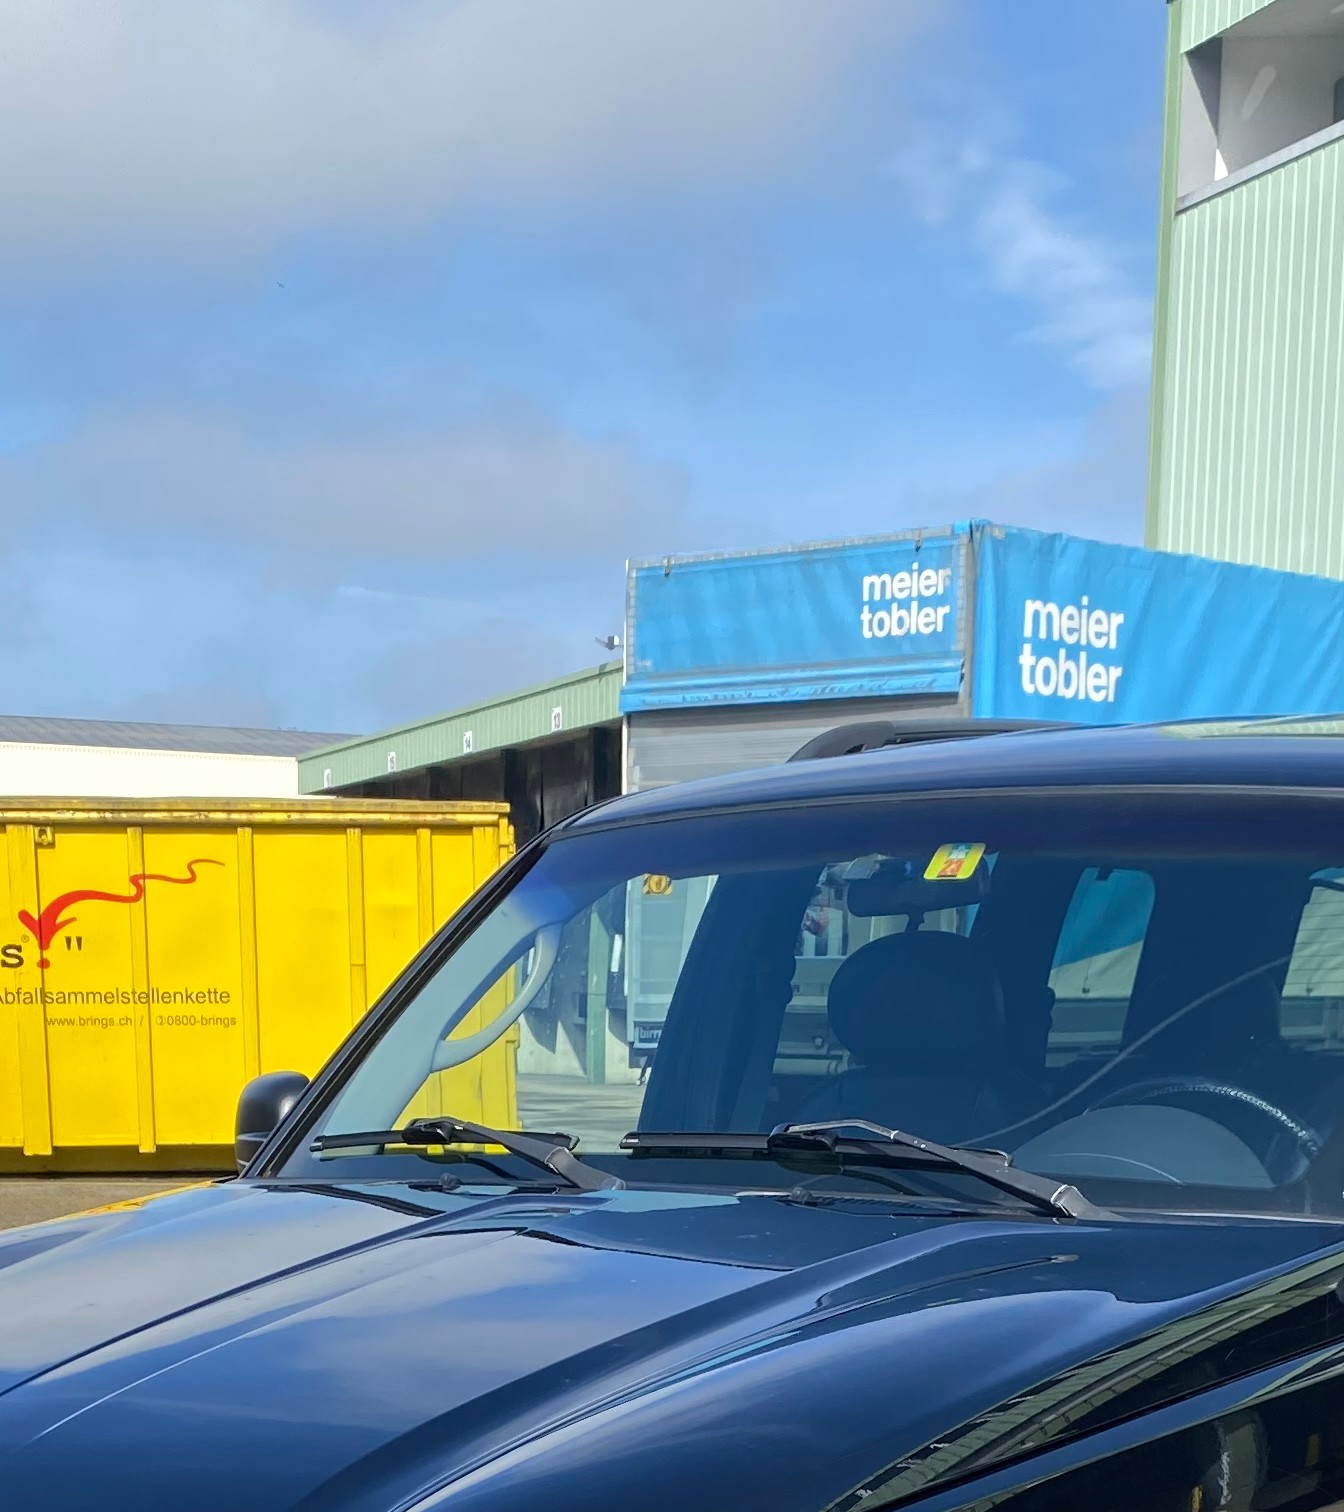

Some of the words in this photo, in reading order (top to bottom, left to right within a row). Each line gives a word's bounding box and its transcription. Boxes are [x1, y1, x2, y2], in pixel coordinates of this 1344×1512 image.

[862, 562, 951, 601] meier
[860, 600, 950, 638] tobler
[1024, 596, 1124, 649] meier
[1020, 642, 1122, 703] tobler
[47, 1015, 132, 1029] www.brings.ch
